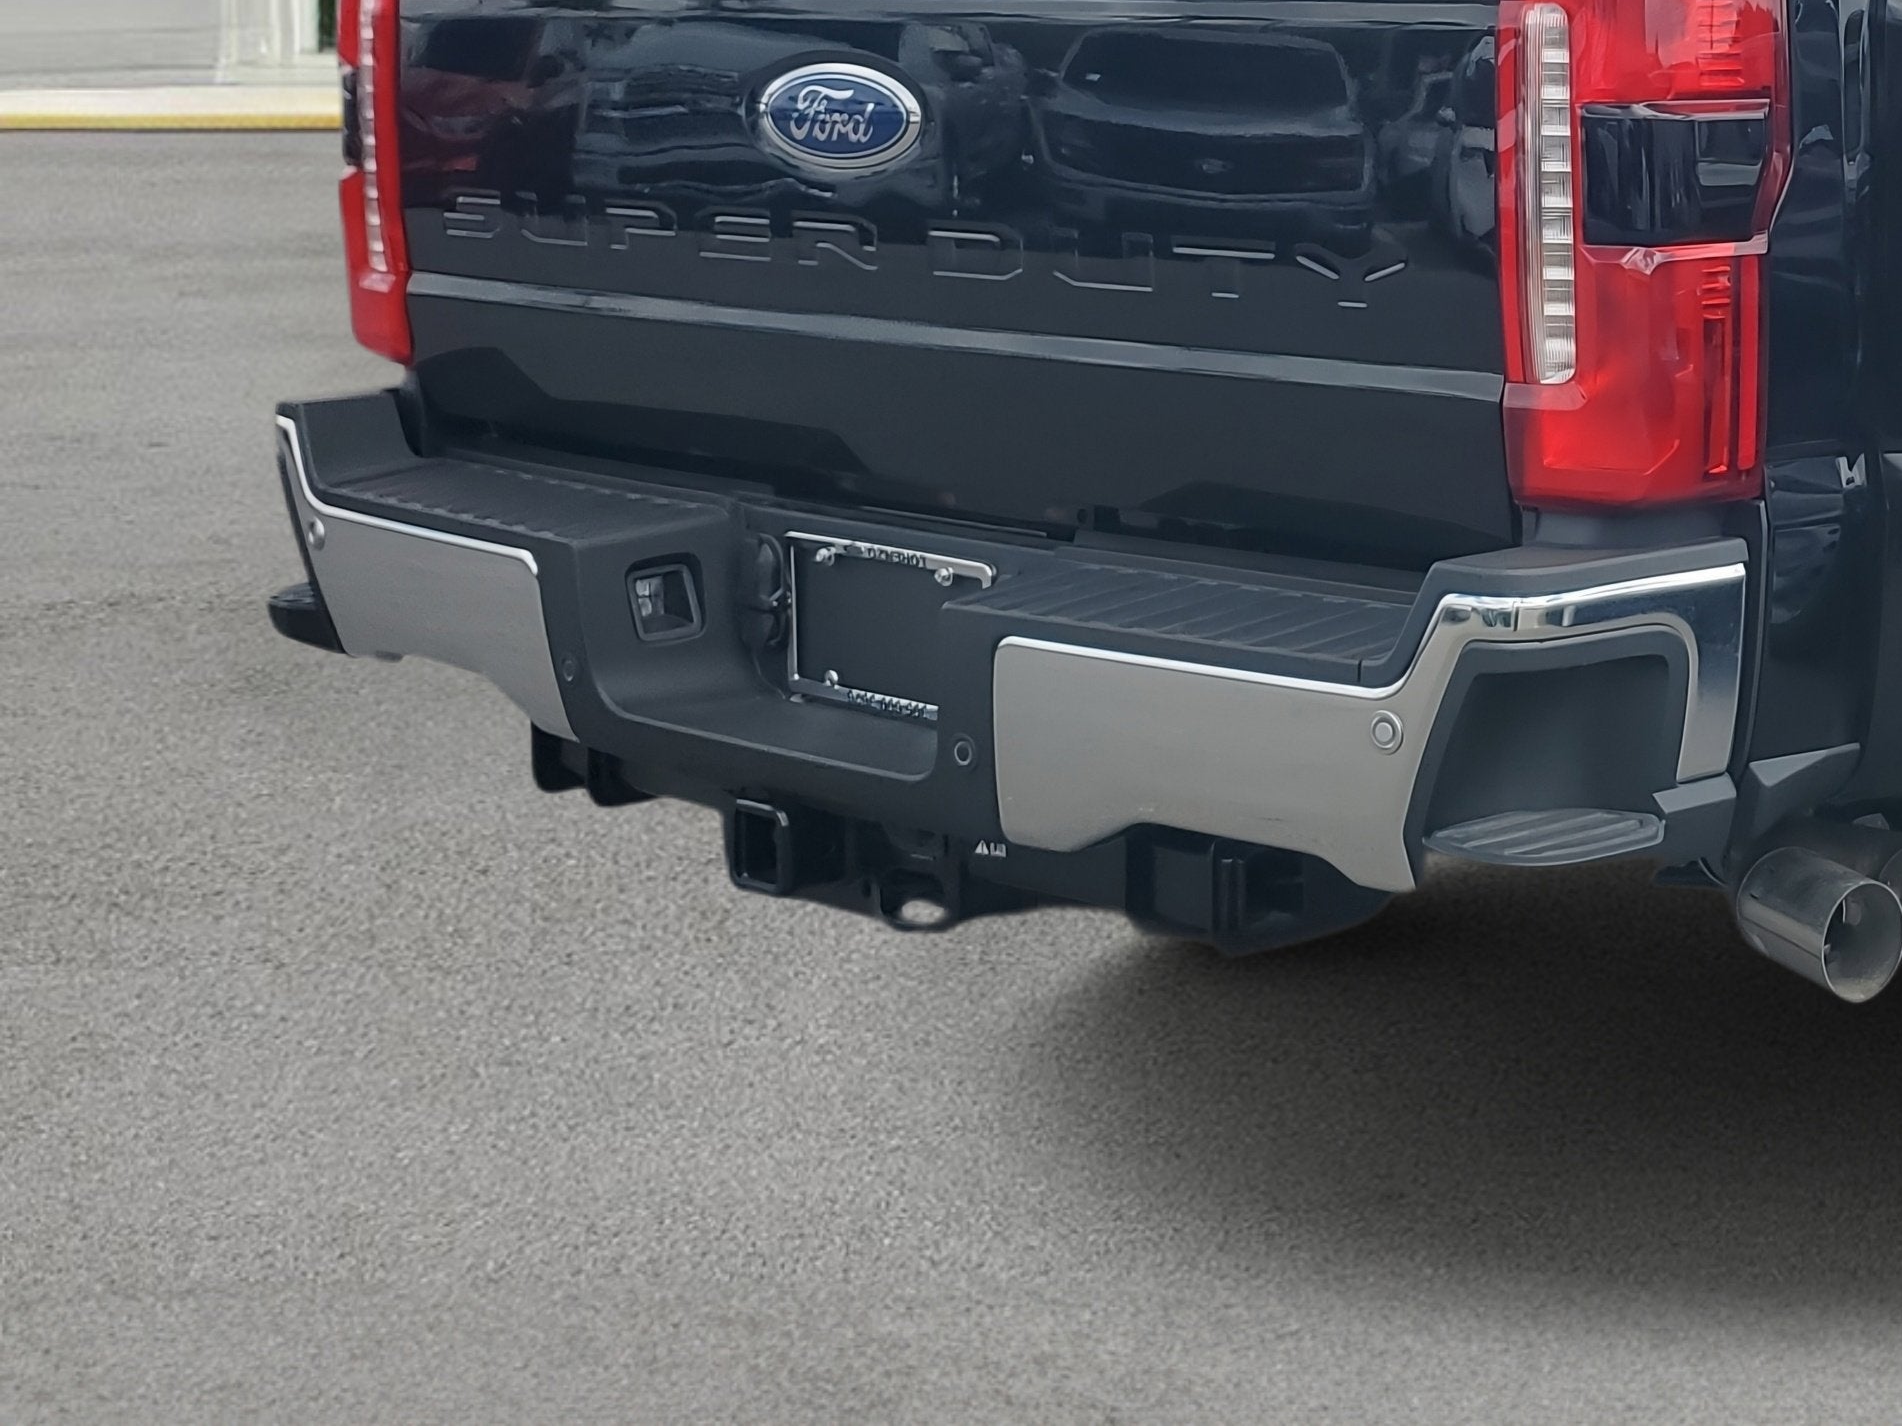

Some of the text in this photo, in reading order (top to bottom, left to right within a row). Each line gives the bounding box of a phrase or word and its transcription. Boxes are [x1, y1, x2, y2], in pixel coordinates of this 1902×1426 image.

[789, 85, 875, 143] Ford
[442, 188, 1410, 310] SUPER DUTY
